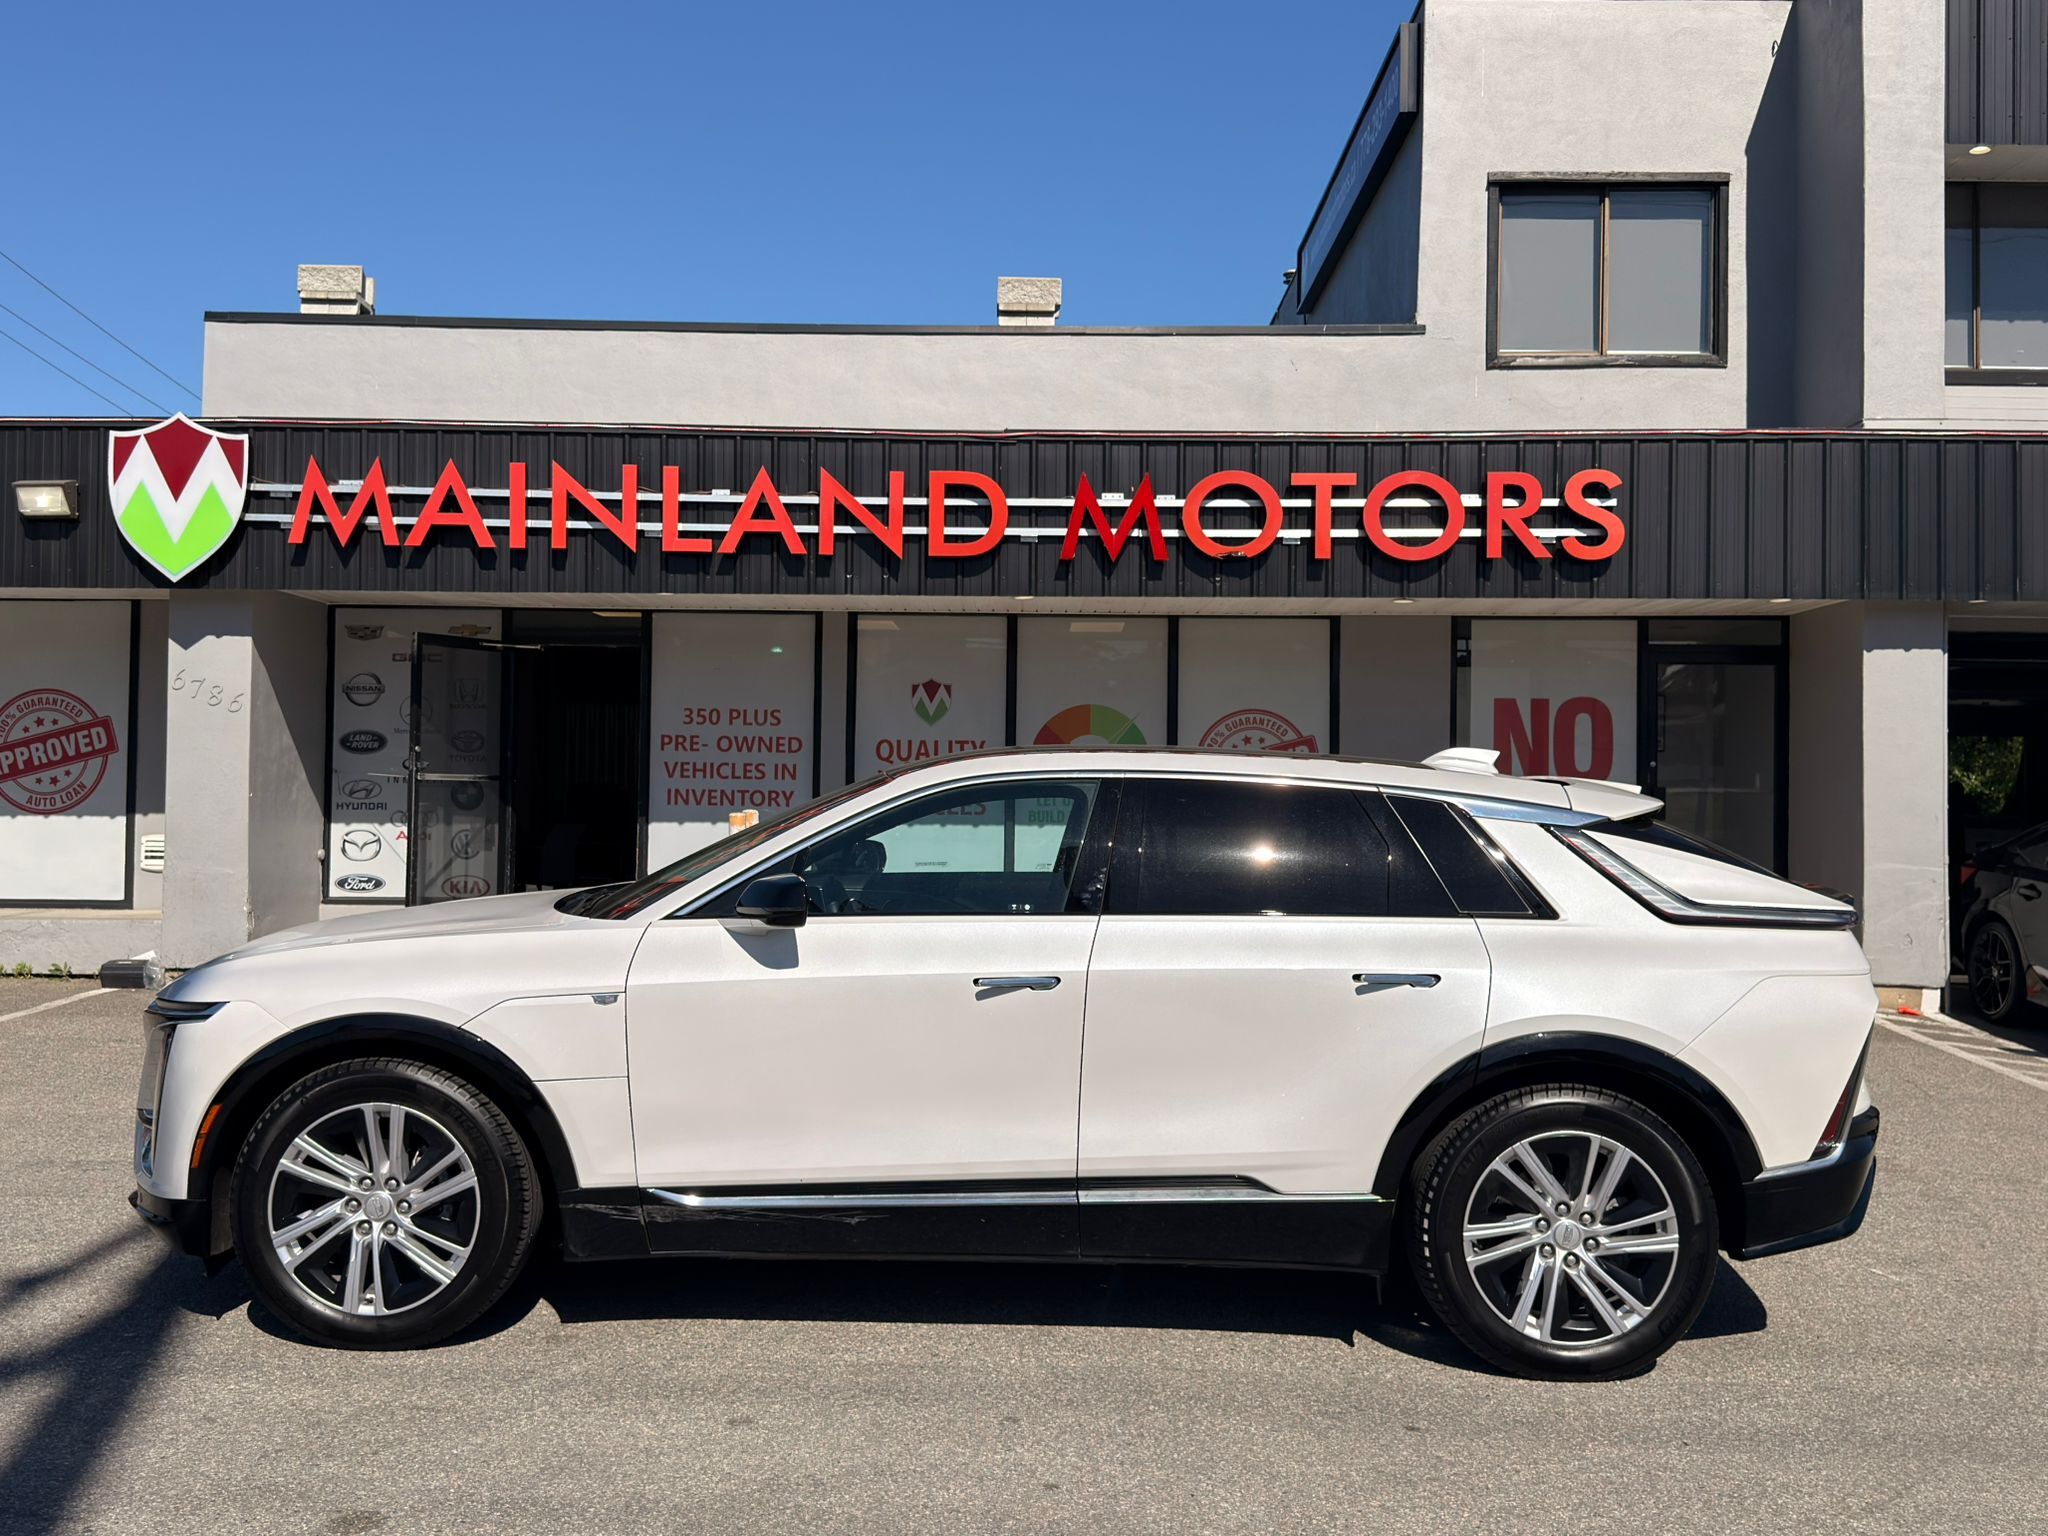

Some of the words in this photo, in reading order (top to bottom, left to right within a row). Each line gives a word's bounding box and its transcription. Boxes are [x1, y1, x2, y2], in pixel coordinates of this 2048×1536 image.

[287, 455, 1009, 559] MAINLAND
[1059, 468, 1625, 562] MOTORS
[392, 653, 443, 662] GC
[171, 668, 245, 714] 6786
[345, 685, 382, 693] NISSAN
[16, 696, 84, 718] GUARANTEED
[682, 707, 721, 726] 350
[728, 708, 782, 727] PLUS
[1225, 716, 1289, 737] GUARANTEED
[351, 741, 380, 749] ROVER
[716, 735, 803, 753] OWNED
[1494, 696, 1613, 780] NO
[0, 726, 108, 776] PPROVED
[664, 761, 766, 780] VEHICLES
[773, 763, 797, 780] IN
[26, 795, 57, 808] AUTO
[60, 781, 88, 805] LOAN
[666, 788, 795, 807] INVENTORY
[336, 802, 387, 811] HYUNDAI
[1028, 810, 1065, 824] BUILD
[344, 877, 376, 890] Ford
[450, 882, 483, 894] KIA
